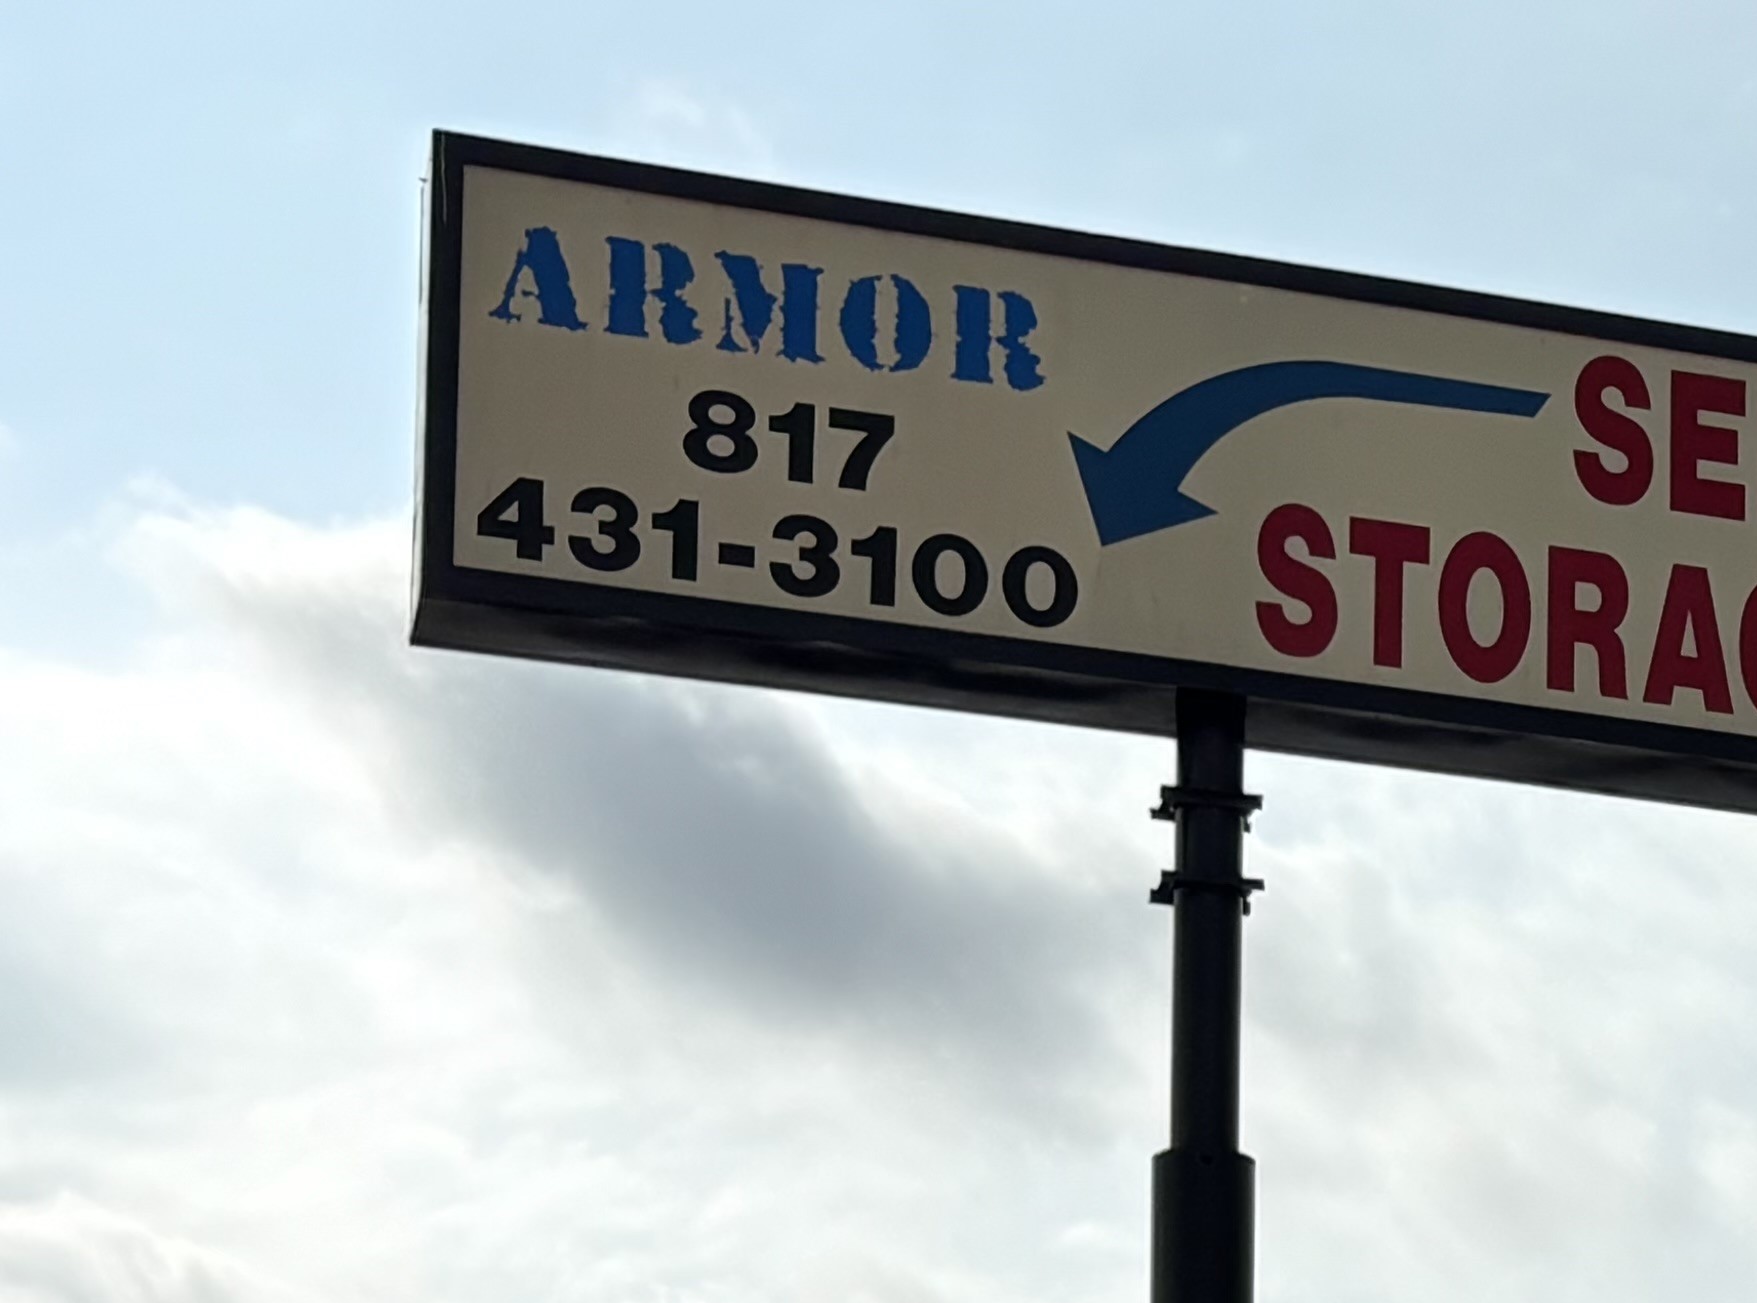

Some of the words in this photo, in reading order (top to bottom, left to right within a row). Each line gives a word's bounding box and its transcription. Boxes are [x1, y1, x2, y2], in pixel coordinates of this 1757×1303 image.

[487, 226, 1045, 391] ARMOR
[682, 389, 895, 492] 817
[476, 477, 1079, 628] 431-3100
